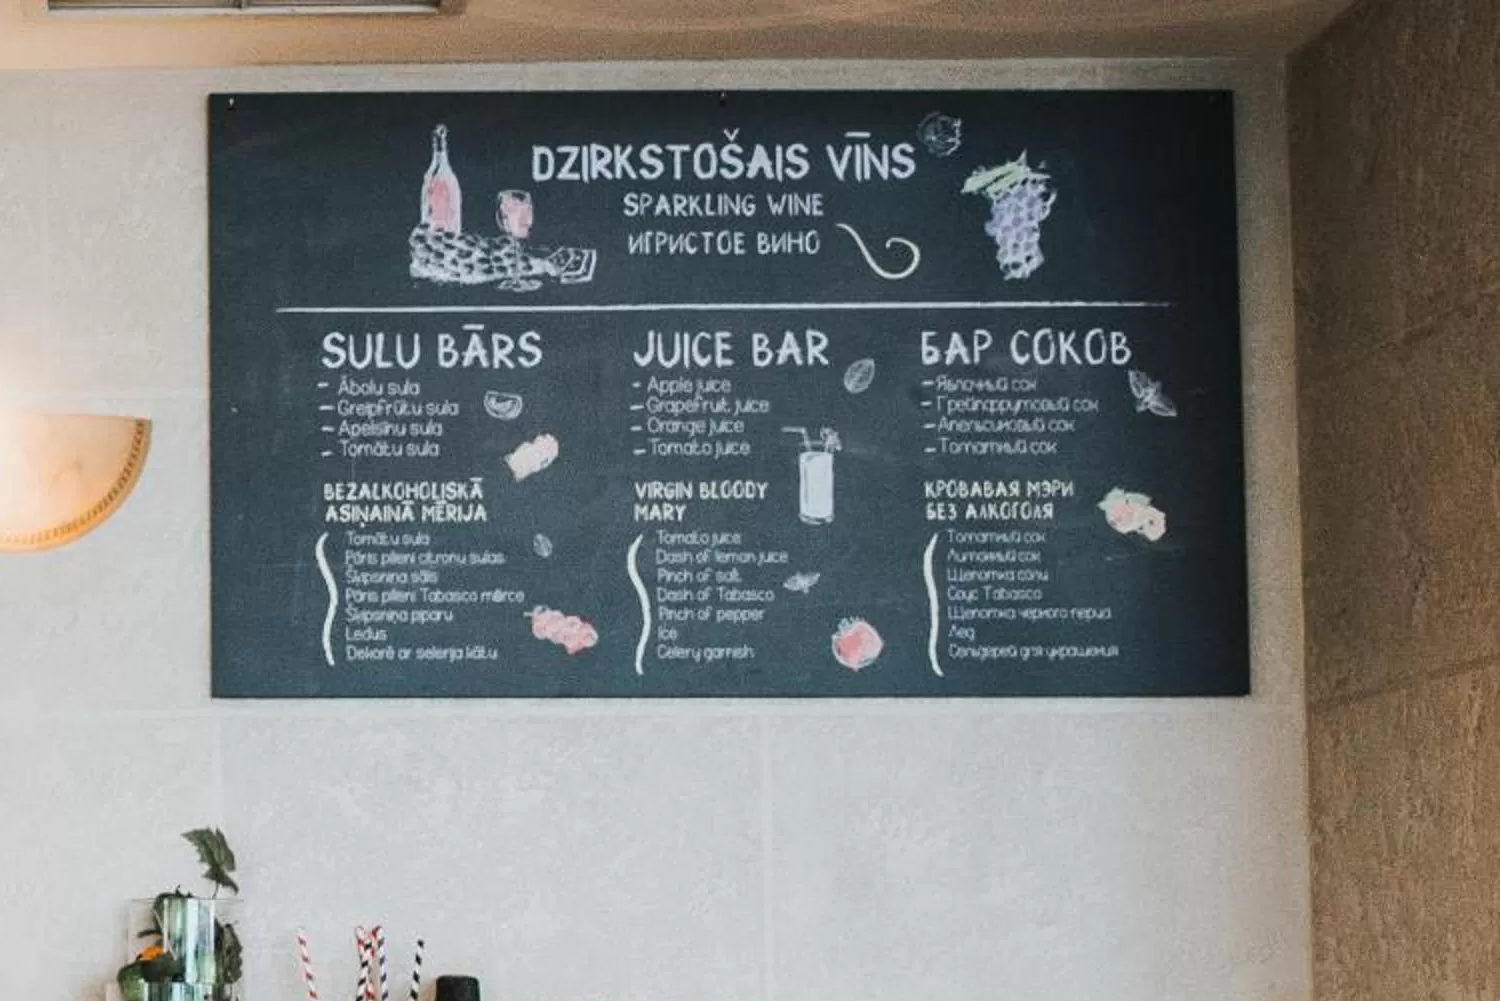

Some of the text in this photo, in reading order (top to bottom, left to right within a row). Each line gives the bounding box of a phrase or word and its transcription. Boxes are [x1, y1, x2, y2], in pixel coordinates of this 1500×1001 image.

[532, 128, 916, 183] DZIRKSTOŠAIS VĪNS
[624, 192, 823, 218] SPARKLING WINE
[628, 229, 820, 255] ИГРИСТОЕ ВИНО
[322, 324, 542, 369] SULU BĀRS
[633, 329, 830, 368] JUICE BAR
[921, 328, 1132, 366] БАР СОКОВ
[338, 375, 420, 396] Ābolu sula
[647, 376, 732, 396] Apple juice
[1011, 378, 1037, 392] сок
[426, 400, 459, 417] sula
[647, 397, 770, 416] Grapefruit juice
[1072, 397, 1099, 413] сок
[409, 420, 443, 437] sula
[647, 416, 744, 436] Orange juice
[1047, 418, 1076, 433] сок
[340, 440, 440, 457] Tomātu sula
[648, 438, 751, 459] Tomato juice
[1029, 440, 1058, 456] сок
[324, 477, 483, 500] BEZALKOHOLISKĀ
[635, 480, 768, 500] VIRGIN BLOODY
[924, 480, 1075, 498] КРОВАВАЯ МЭРИ
[325, 499, 487, 528] ASIŅAINĀ MĒRIJA
[634, 503, 687, 522] MARY
[926, 502, 1054, 520] БЕЗ АЛКОГОЛЯ
[656, 529, 741, 548] Tomato juice
[656, 547, 693, 565] Dash
[695, 547, 712, 564] of
[758, 549, 789, 566] juice
[695, 567, 713, 583] of
[420, 587, 478, 602] Tabasco
[656, 586, 775, 603] Dash of Tabasco
[696, 605, 713, 621] of
[716, 608, 766, 624] pepper
[345, 625, 388, 641] Ledus
[657, 625, 678, 641] Ice
